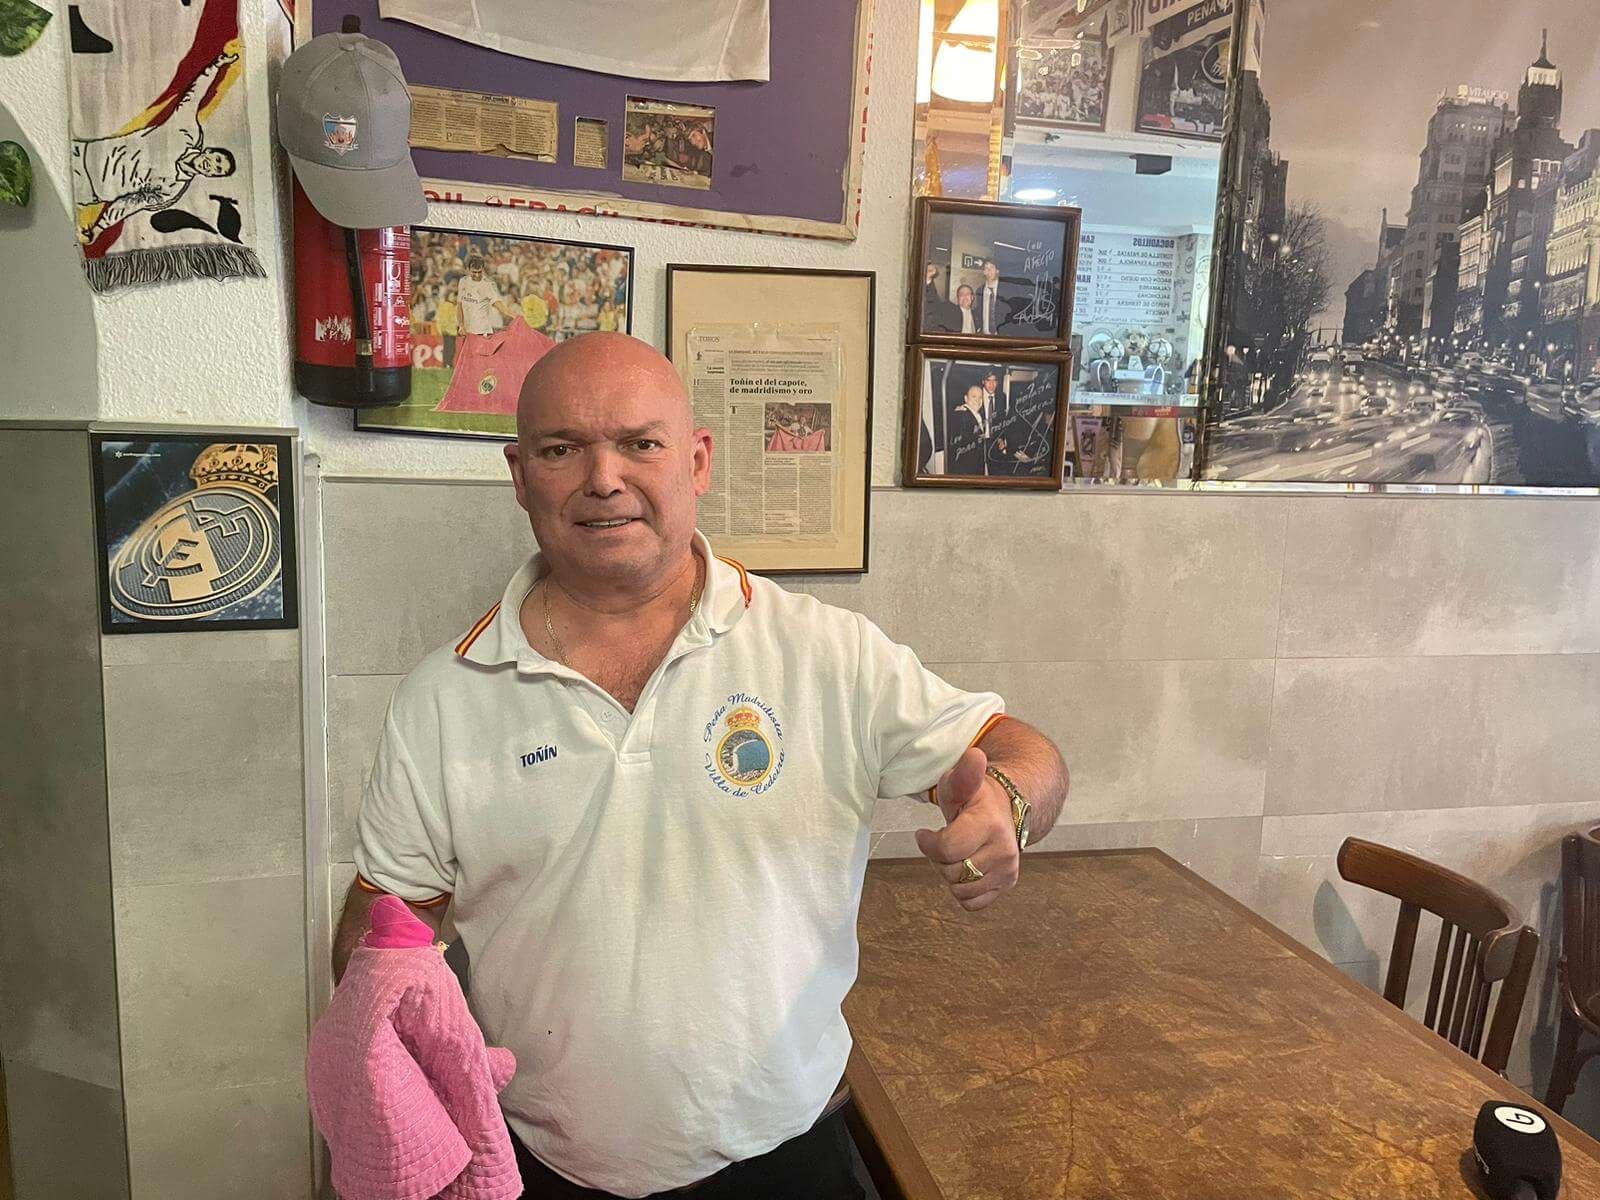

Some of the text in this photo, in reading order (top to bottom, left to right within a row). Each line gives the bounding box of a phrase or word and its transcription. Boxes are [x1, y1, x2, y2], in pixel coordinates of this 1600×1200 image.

[729, 386, 740, 394] de
[741, 386, 791, 395] madridismo
[755, 378, 763, 386] el
[764, 378, 777, 386] del
[778, 379, 807, 388] capote,
[728, 692, 784, 741] Madridista
[704, 752, 731, 794] Villa
[732, 787, 749, 798] de
